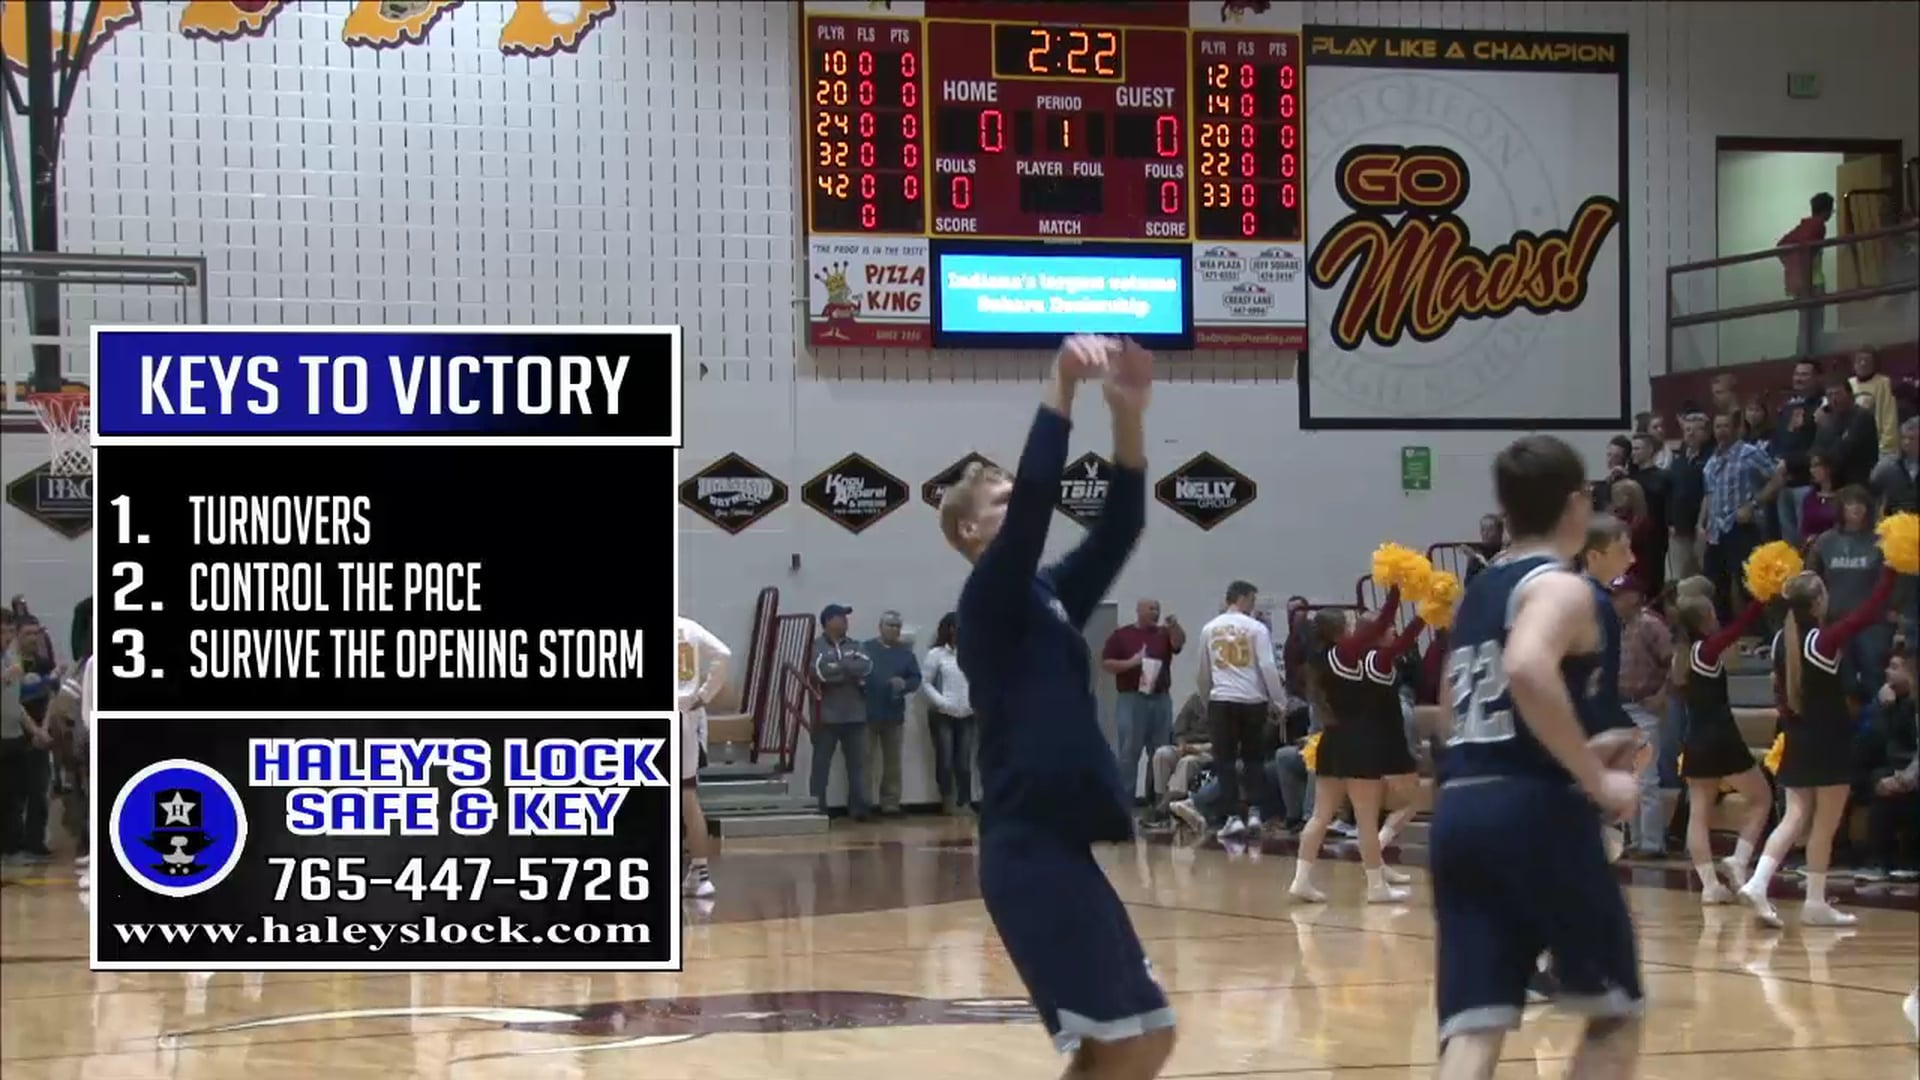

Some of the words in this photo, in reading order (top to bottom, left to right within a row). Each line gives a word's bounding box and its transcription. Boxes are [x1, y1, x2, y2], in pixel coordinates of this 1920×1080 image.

[818, 25, 845, 40] PLYR
[857, 27, 876, 42] FLS
[890, 29, 910, 44] PTS
[1029, 30, 1116, 75] 2:22
[1201, 41, 1227, 56] PLYR
[1238, 41, 1255, 56] FLS
[1269, 42, 1287, 57] PTS
[1311, 37, 1378, 56] PLAY
[1385, 39, 1437, 58] LIKE
[1445, 41, 1467, 59] A
[1473, 41, 1615, 62] CHAMPION
[824, 51, 846, 75] 10
[859, 52, 873, 75] 0
[901, 52, 915, 77] 0
[1208, 64, 1229, 88] 12
[1240, 65, 1253, 89] 0
[1280, 65, 1293, 90] 0
[816, 80, 848, 105] 20
[860, 80, 873, 105] 0
[902, 82, 915, 107] 0
[944, 80, 998, 101] HOME
[1116, 86, 1175, 108] GUEST
[1037, 95, 1082, 111] PERIOD
[1208, 94, 1229, 114] 14
[1241, 94, 1253, 117] 0
[1281, 94, 1293, 117] 0
[817, 112, 849, 136] 24
[860, 113, 873, 137] 0
[903, 114, 916, 139] 0
[980, 110, 1003, 152] 0
[1063, 119, 1069, 148] 1
[1157, 115, 1178, 157] 0
[1201, 124, 1229, 148] 20
[1241, 124, 1254, 148] 0
[1281, 125, 1294, 149] 0
[820, 142, 849, 167] 32
[861, 142, 874, 167] 0
[904, 144, 917, 168] 0
[936, 159, 976, 174] FOULS
[1201, 153, 1230, 176] 22
[1242, 153, 1254, 176] 0
[1281, 153, 1294, 177] 0
[1016, 161, 1063, 175] PLAYER
[1073, 162, 1104, 176] FOUL
[1145, 164, 1184, 179] FOULS
[1342, 152, 1463, 207] GO
[818, 174, 849, 198] 42
[861, 174, 875, 199] 0
[904, 175, 917, 199] 0
[952, 176, 969, 209] 0
[1161, 181, 1178, 214] 0
[1203, 183, 1230, 207] 33
[1242, 184, 1254, 208] 0
[1282, 184, 1294, 208] 0
[862, 203, 876, 228] 0
[935, 217, 977, 233] SCORE
[1039, 220, 1081, 234] MATCH
[1243, 212, 1255, 236] 0
[1145, 221, 1186, 237] SCORE
[865, 263, 926, 286] PIZZA
[1217, 261, 1241, 269] PLAZA
[1253, 261, 1269, 269] JEFF
[1270, 261, 1298, 270] SQUARE
[1313, 201, 1614, 345] Mavs!
[866, 290, 922, 313] KING
[1176, 480, 1236, 498] KELLY
[1198, 497, 1237, 509] GROUP
[1447, 638, 1516, 747] 22
